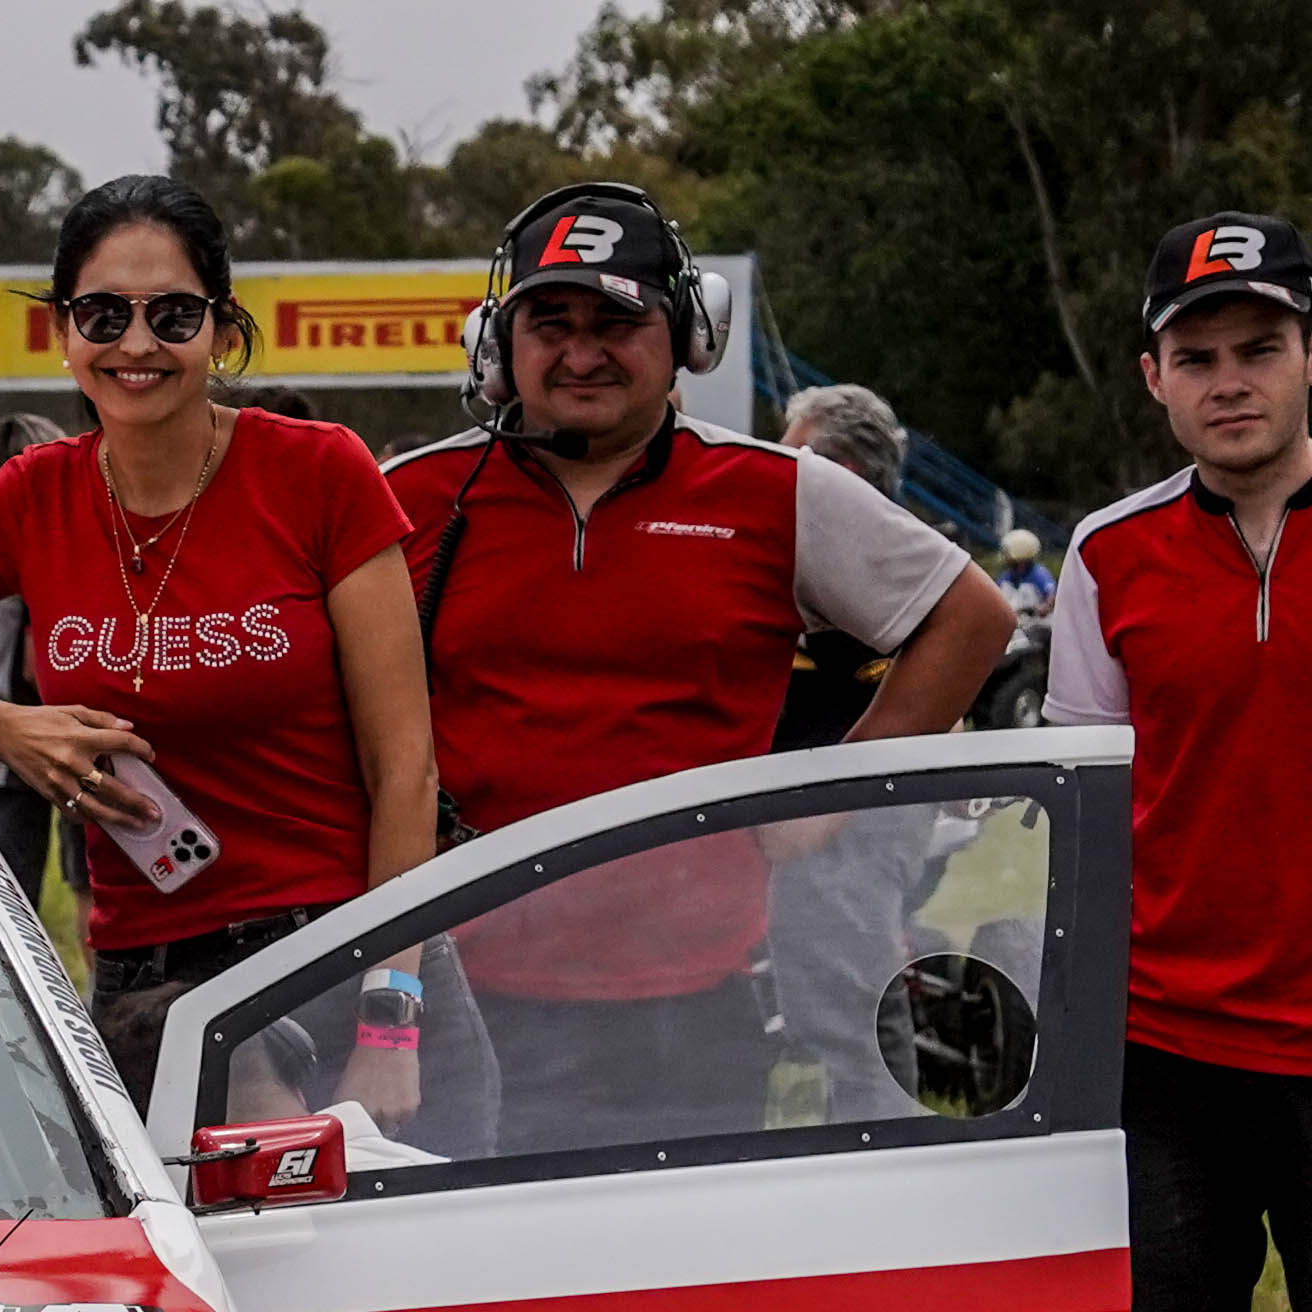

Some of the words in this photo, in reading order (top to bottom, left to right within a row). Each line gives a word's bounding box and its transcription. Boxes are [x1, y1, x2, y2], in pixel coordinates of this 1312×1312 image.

[276, 299, 484, 349] PIRELL
[47, 603, 290, 672] GUESS
[64, 1018, 129, 1102] LUCAS
[277, 1149, 317, 1175] 61
